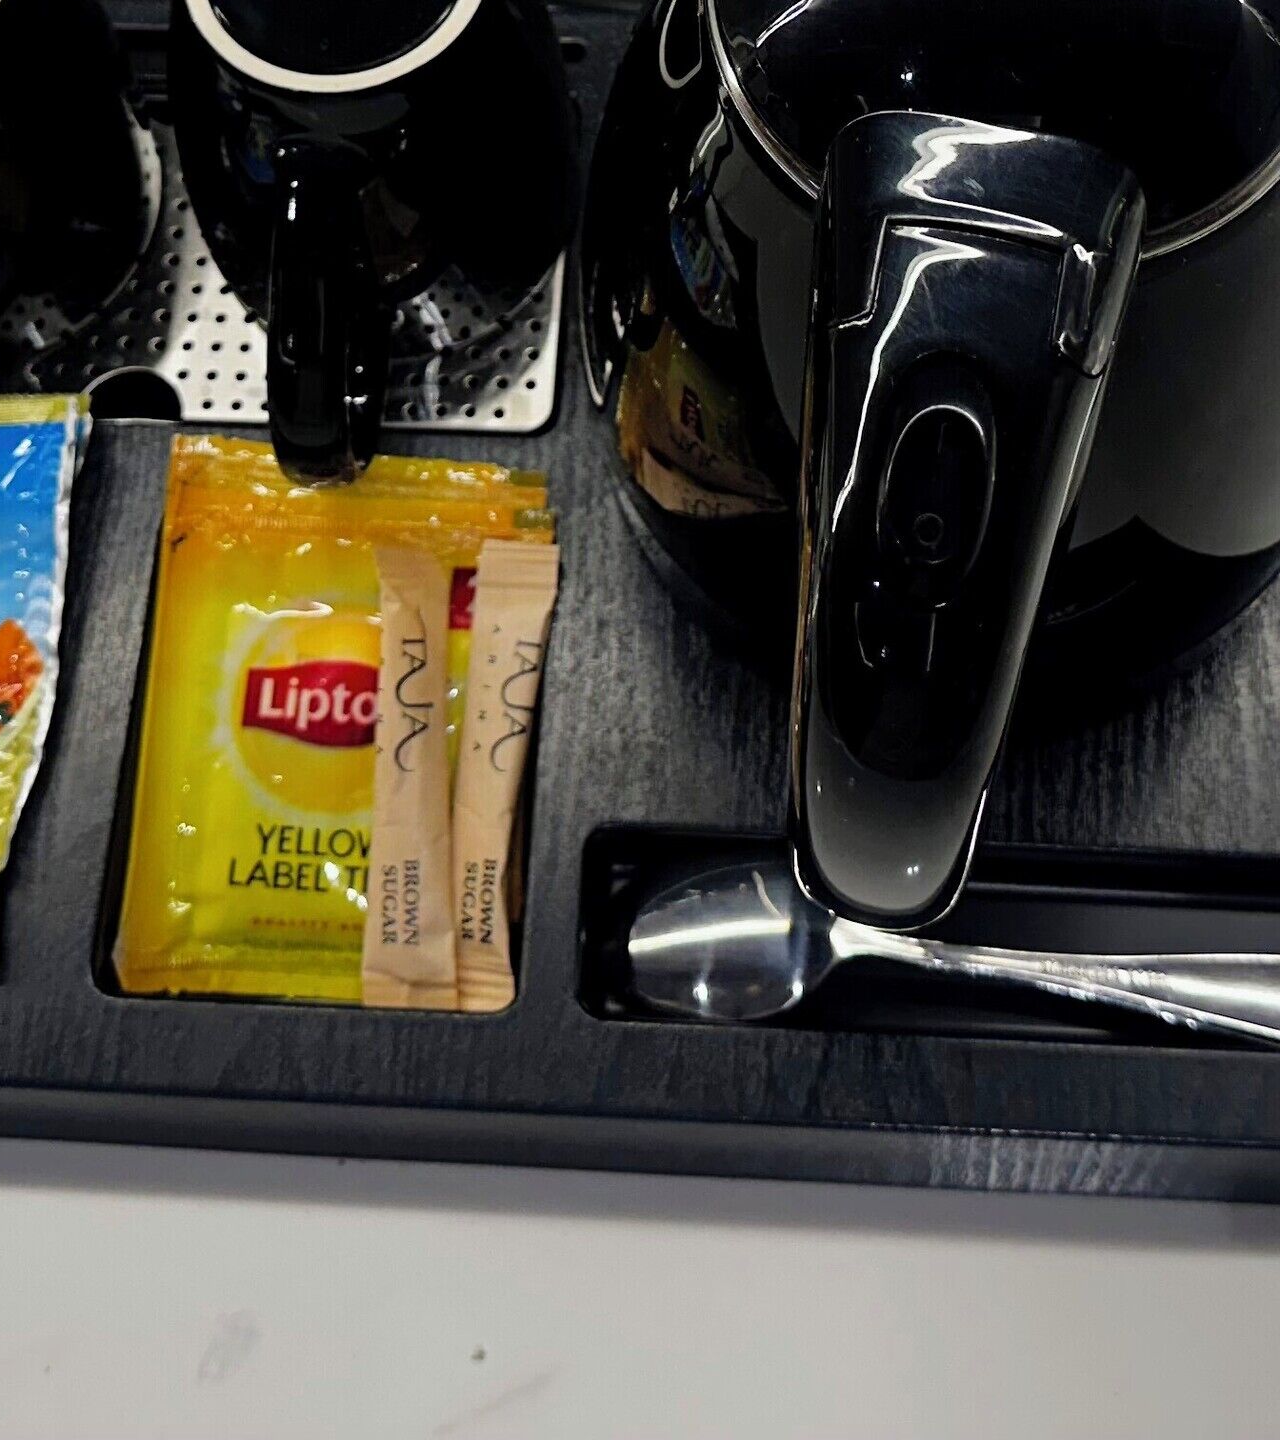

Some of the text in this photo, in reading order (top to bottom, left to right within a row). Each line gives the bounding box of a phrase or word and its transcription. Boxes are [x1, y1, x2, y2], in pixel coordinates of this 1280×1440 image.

[258, 676, 377, 731] Lipto
[228, 859, 328, 892] LABEL
[382, 864, 398, 944] SUGAR
[404, 859, 419, 944] BROWN
[461, 861, 479, 940] SUGAR
[480, 858, 497, 944] BROWN
